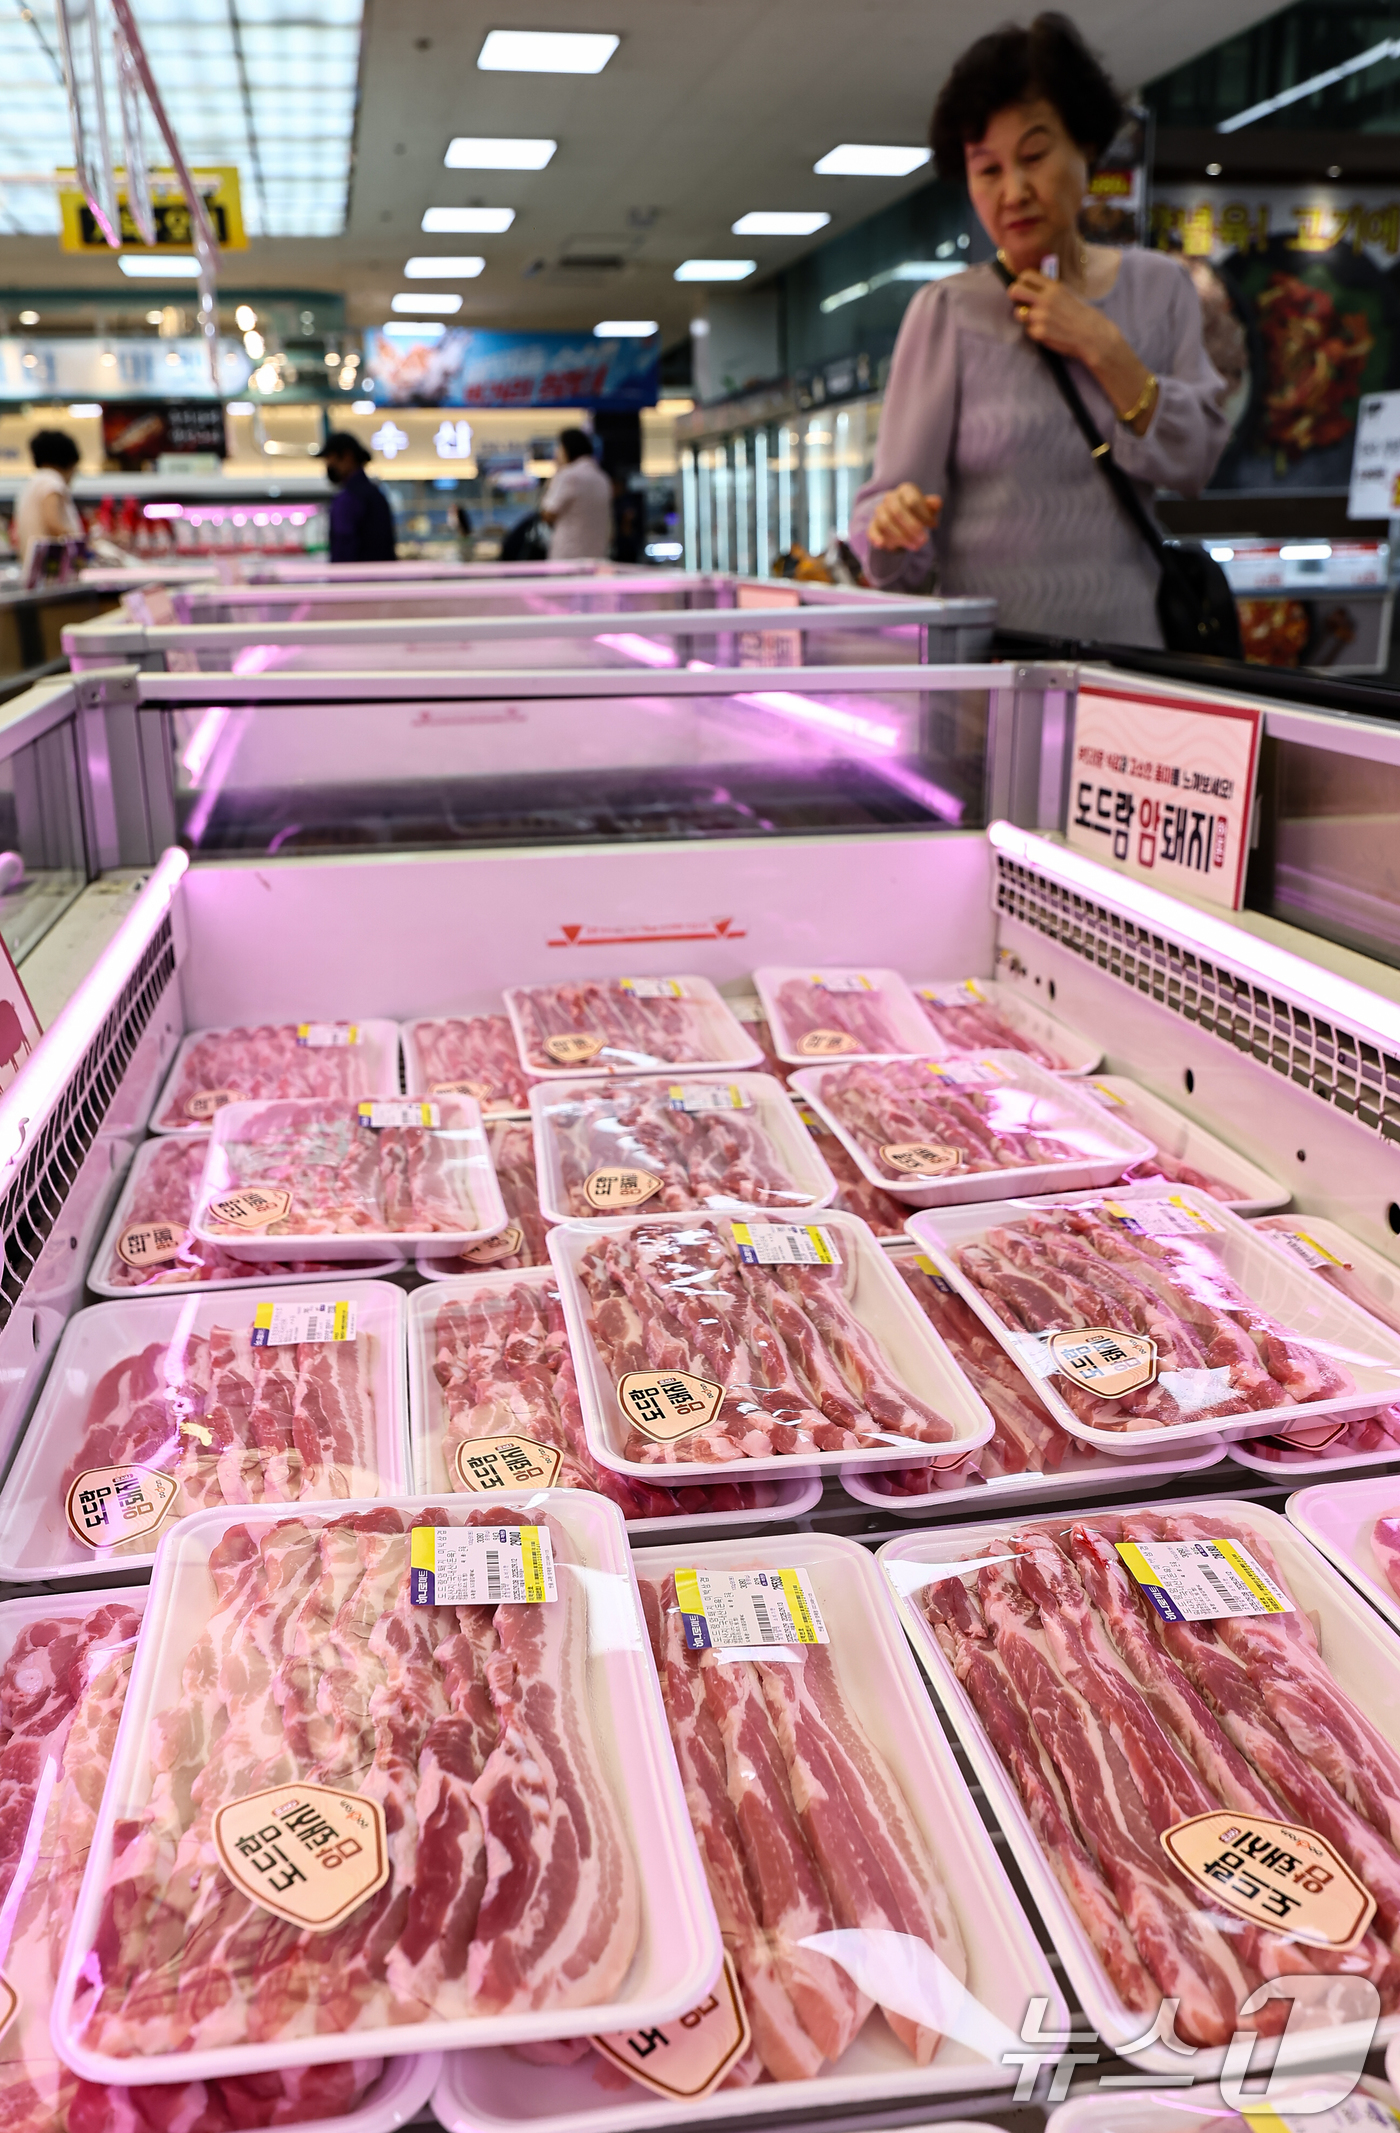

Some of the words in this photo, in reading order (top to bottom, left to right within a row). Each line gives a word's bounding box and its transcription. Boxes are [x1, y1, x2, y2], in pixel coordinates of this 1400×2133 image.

[1074, 782, 1135, 861] 도드람
[1137, 797, 1215, 874] 암돼지
[1060, 1344, 1104, 1380] 도드람
[627, 1385, 666, 1423] 도드람
[661, 1379, 706, 1417] 암돼지
[467, 1452, 505, 1491] 도드람
[499, 1443, 544, 1483] 암돼지
[78, 1486, 111, 1529] 도드람
[113, 1477, 154, 1521] 암돼지
[508, 1531, 522, 1546] 29040
[415, 1570, 427, 1604] 하나로마트
[1148, 1586, 1177, 1622] 하나로마트
[688, 1615, 704, 1646] 하나로마트
[280, 1802, 364, 1870] 암돼지
[233, 1824, 308, 1892] 도드람
[1231, 1830, 1335, 1894] 암돼지
[1202, 1850, 1303, 1919] 도드람
